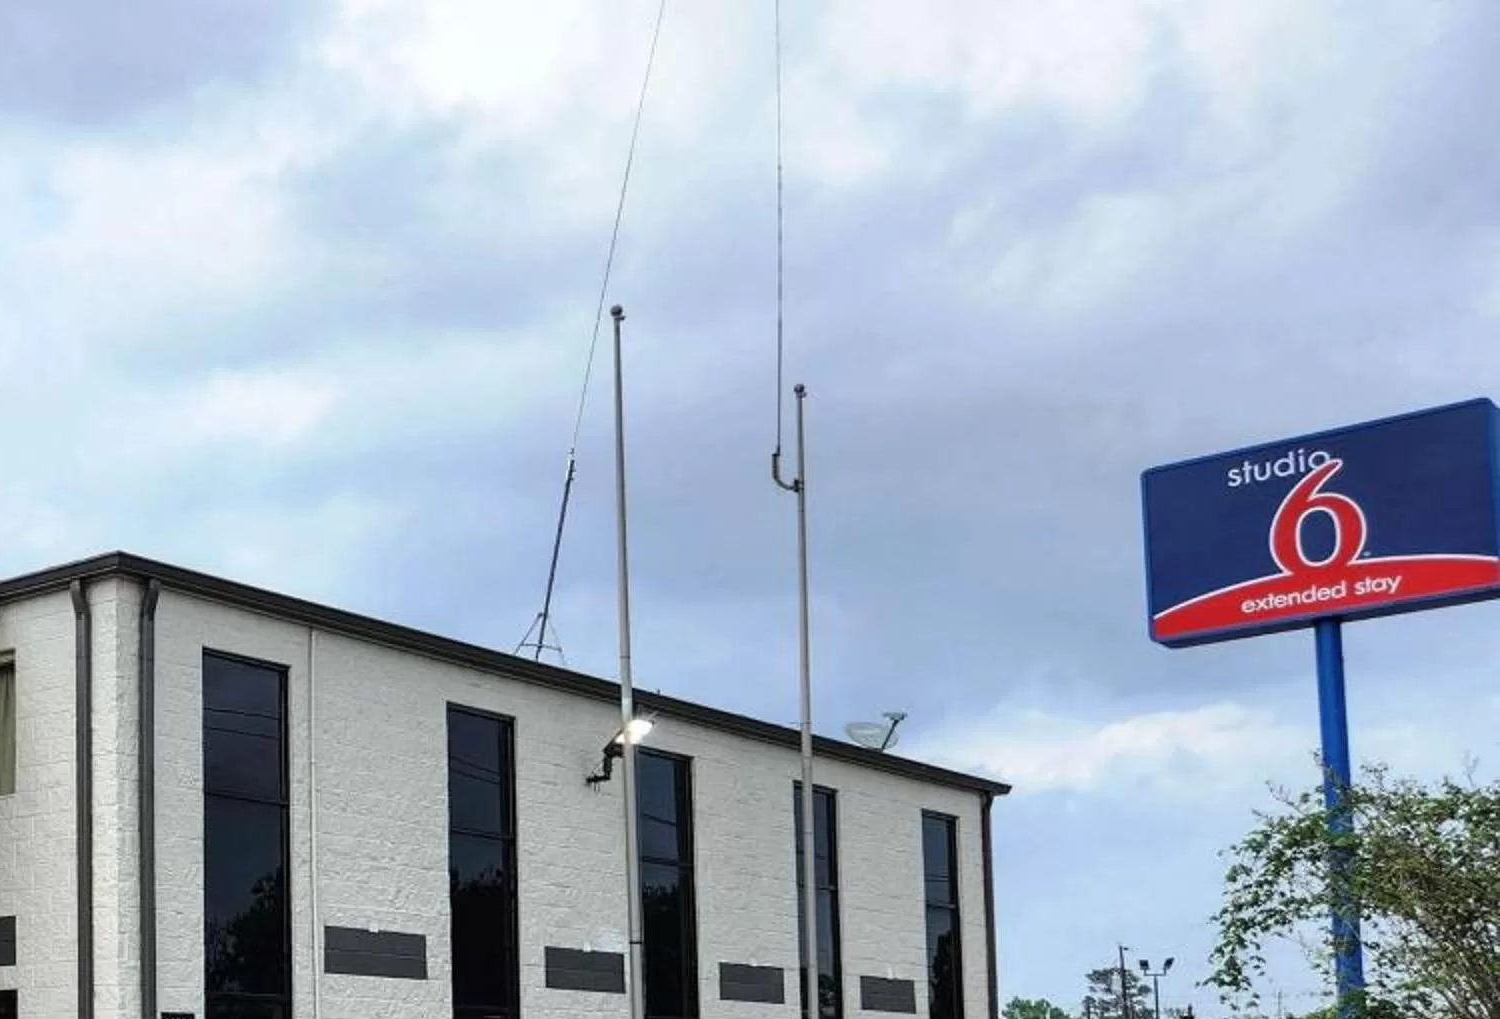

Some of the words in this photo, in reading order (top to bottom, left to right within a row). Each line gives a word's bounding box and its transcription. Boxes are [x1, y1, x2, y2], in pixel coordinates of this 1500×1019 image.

[1227, 448, 1331, 488] studio
[1269, 458, 1367, 574] 6
[1241, 579, 1347, 613] extended
[1353, 574, 1403, 597] stay
